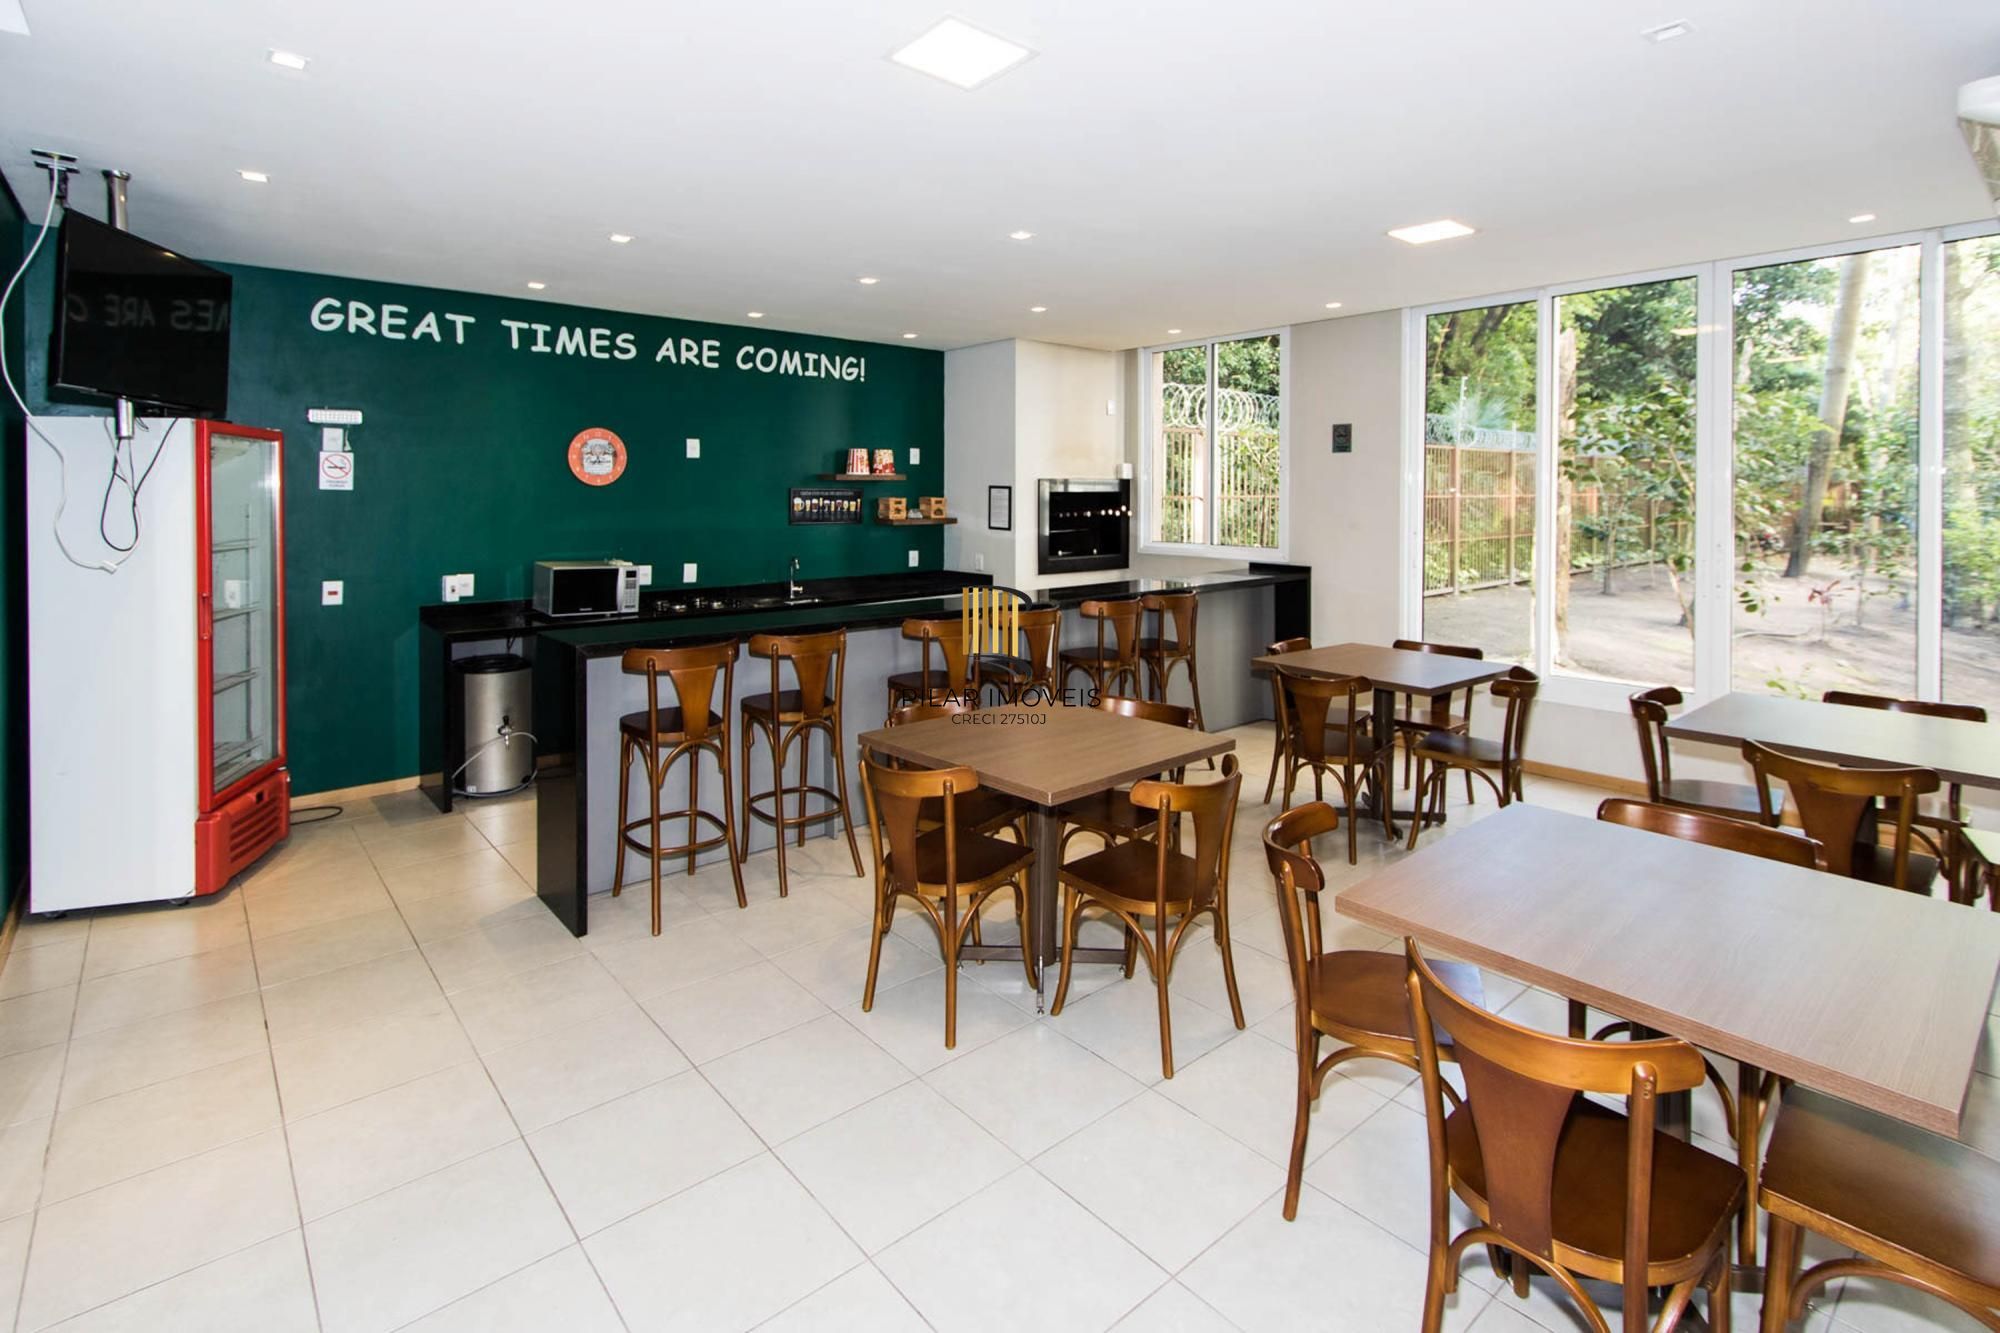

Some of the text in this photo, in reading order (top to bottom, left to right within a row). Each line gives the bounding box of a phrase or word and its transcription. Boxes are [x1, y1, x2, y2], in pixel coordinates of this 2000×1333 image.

[310, 298, 866, 382] GREAT TIMES ARE COMING!
